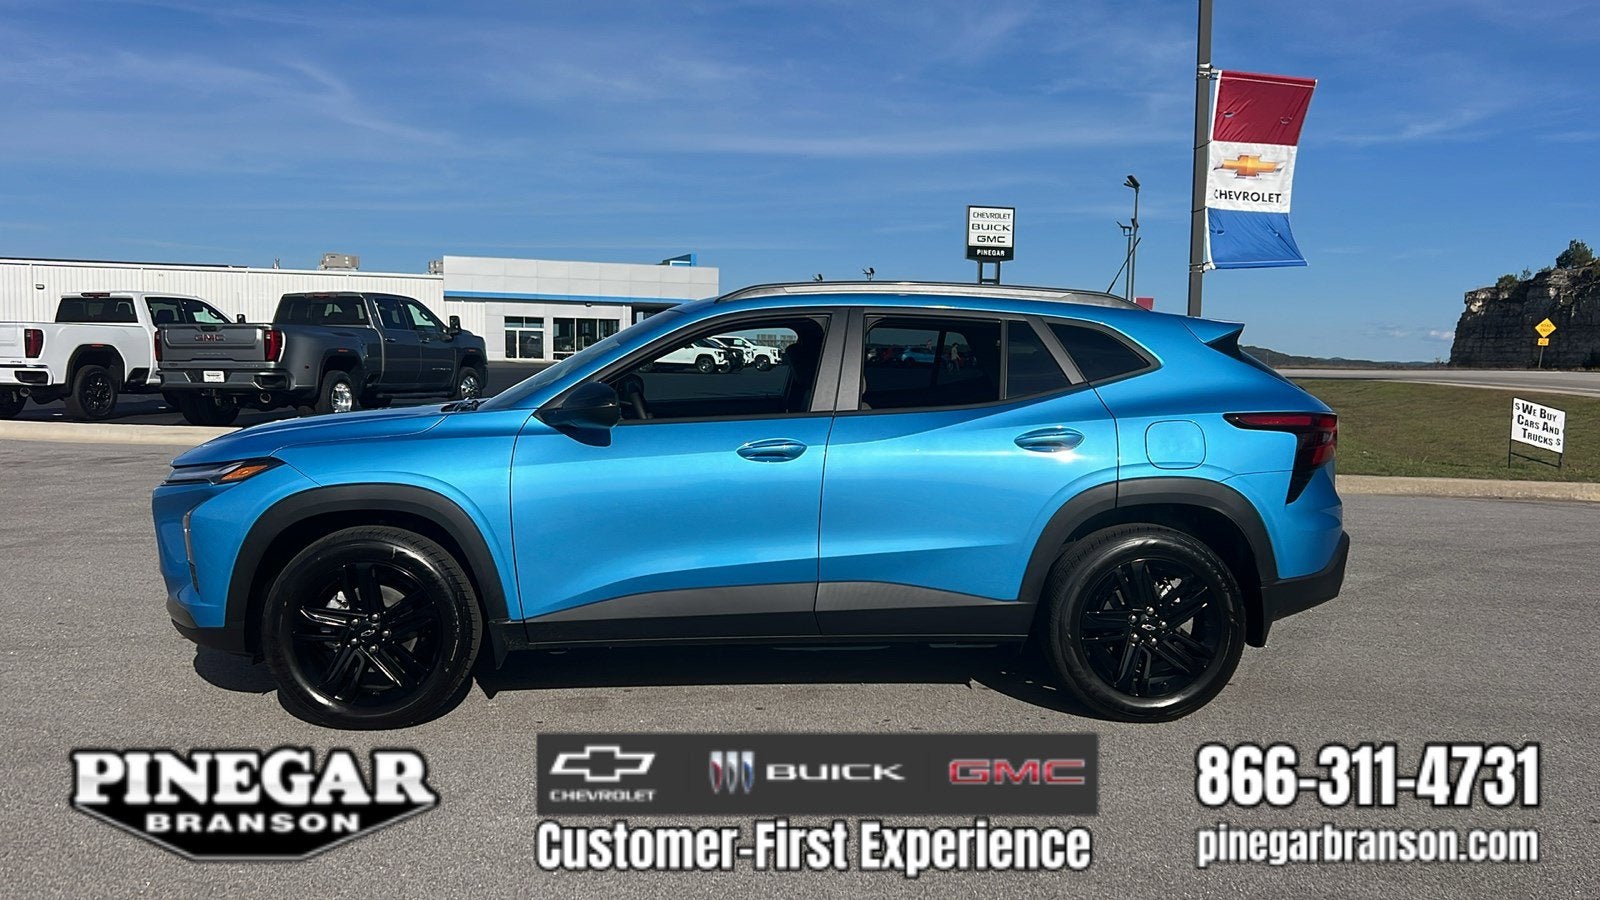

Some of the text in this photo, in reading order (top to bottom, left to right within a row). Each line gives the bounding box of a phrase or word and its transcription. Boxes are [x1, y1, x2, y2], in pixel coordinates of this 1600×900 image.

[1214, 188, 1282, 204] CHEVROLET
[972, 211, 1011, 220] CHEVROLET
[971, 223, 1011, 232] BUICK
[976, 235, 1006, 243] GMC
[976, 249, 1005, 257] PINEGAR
